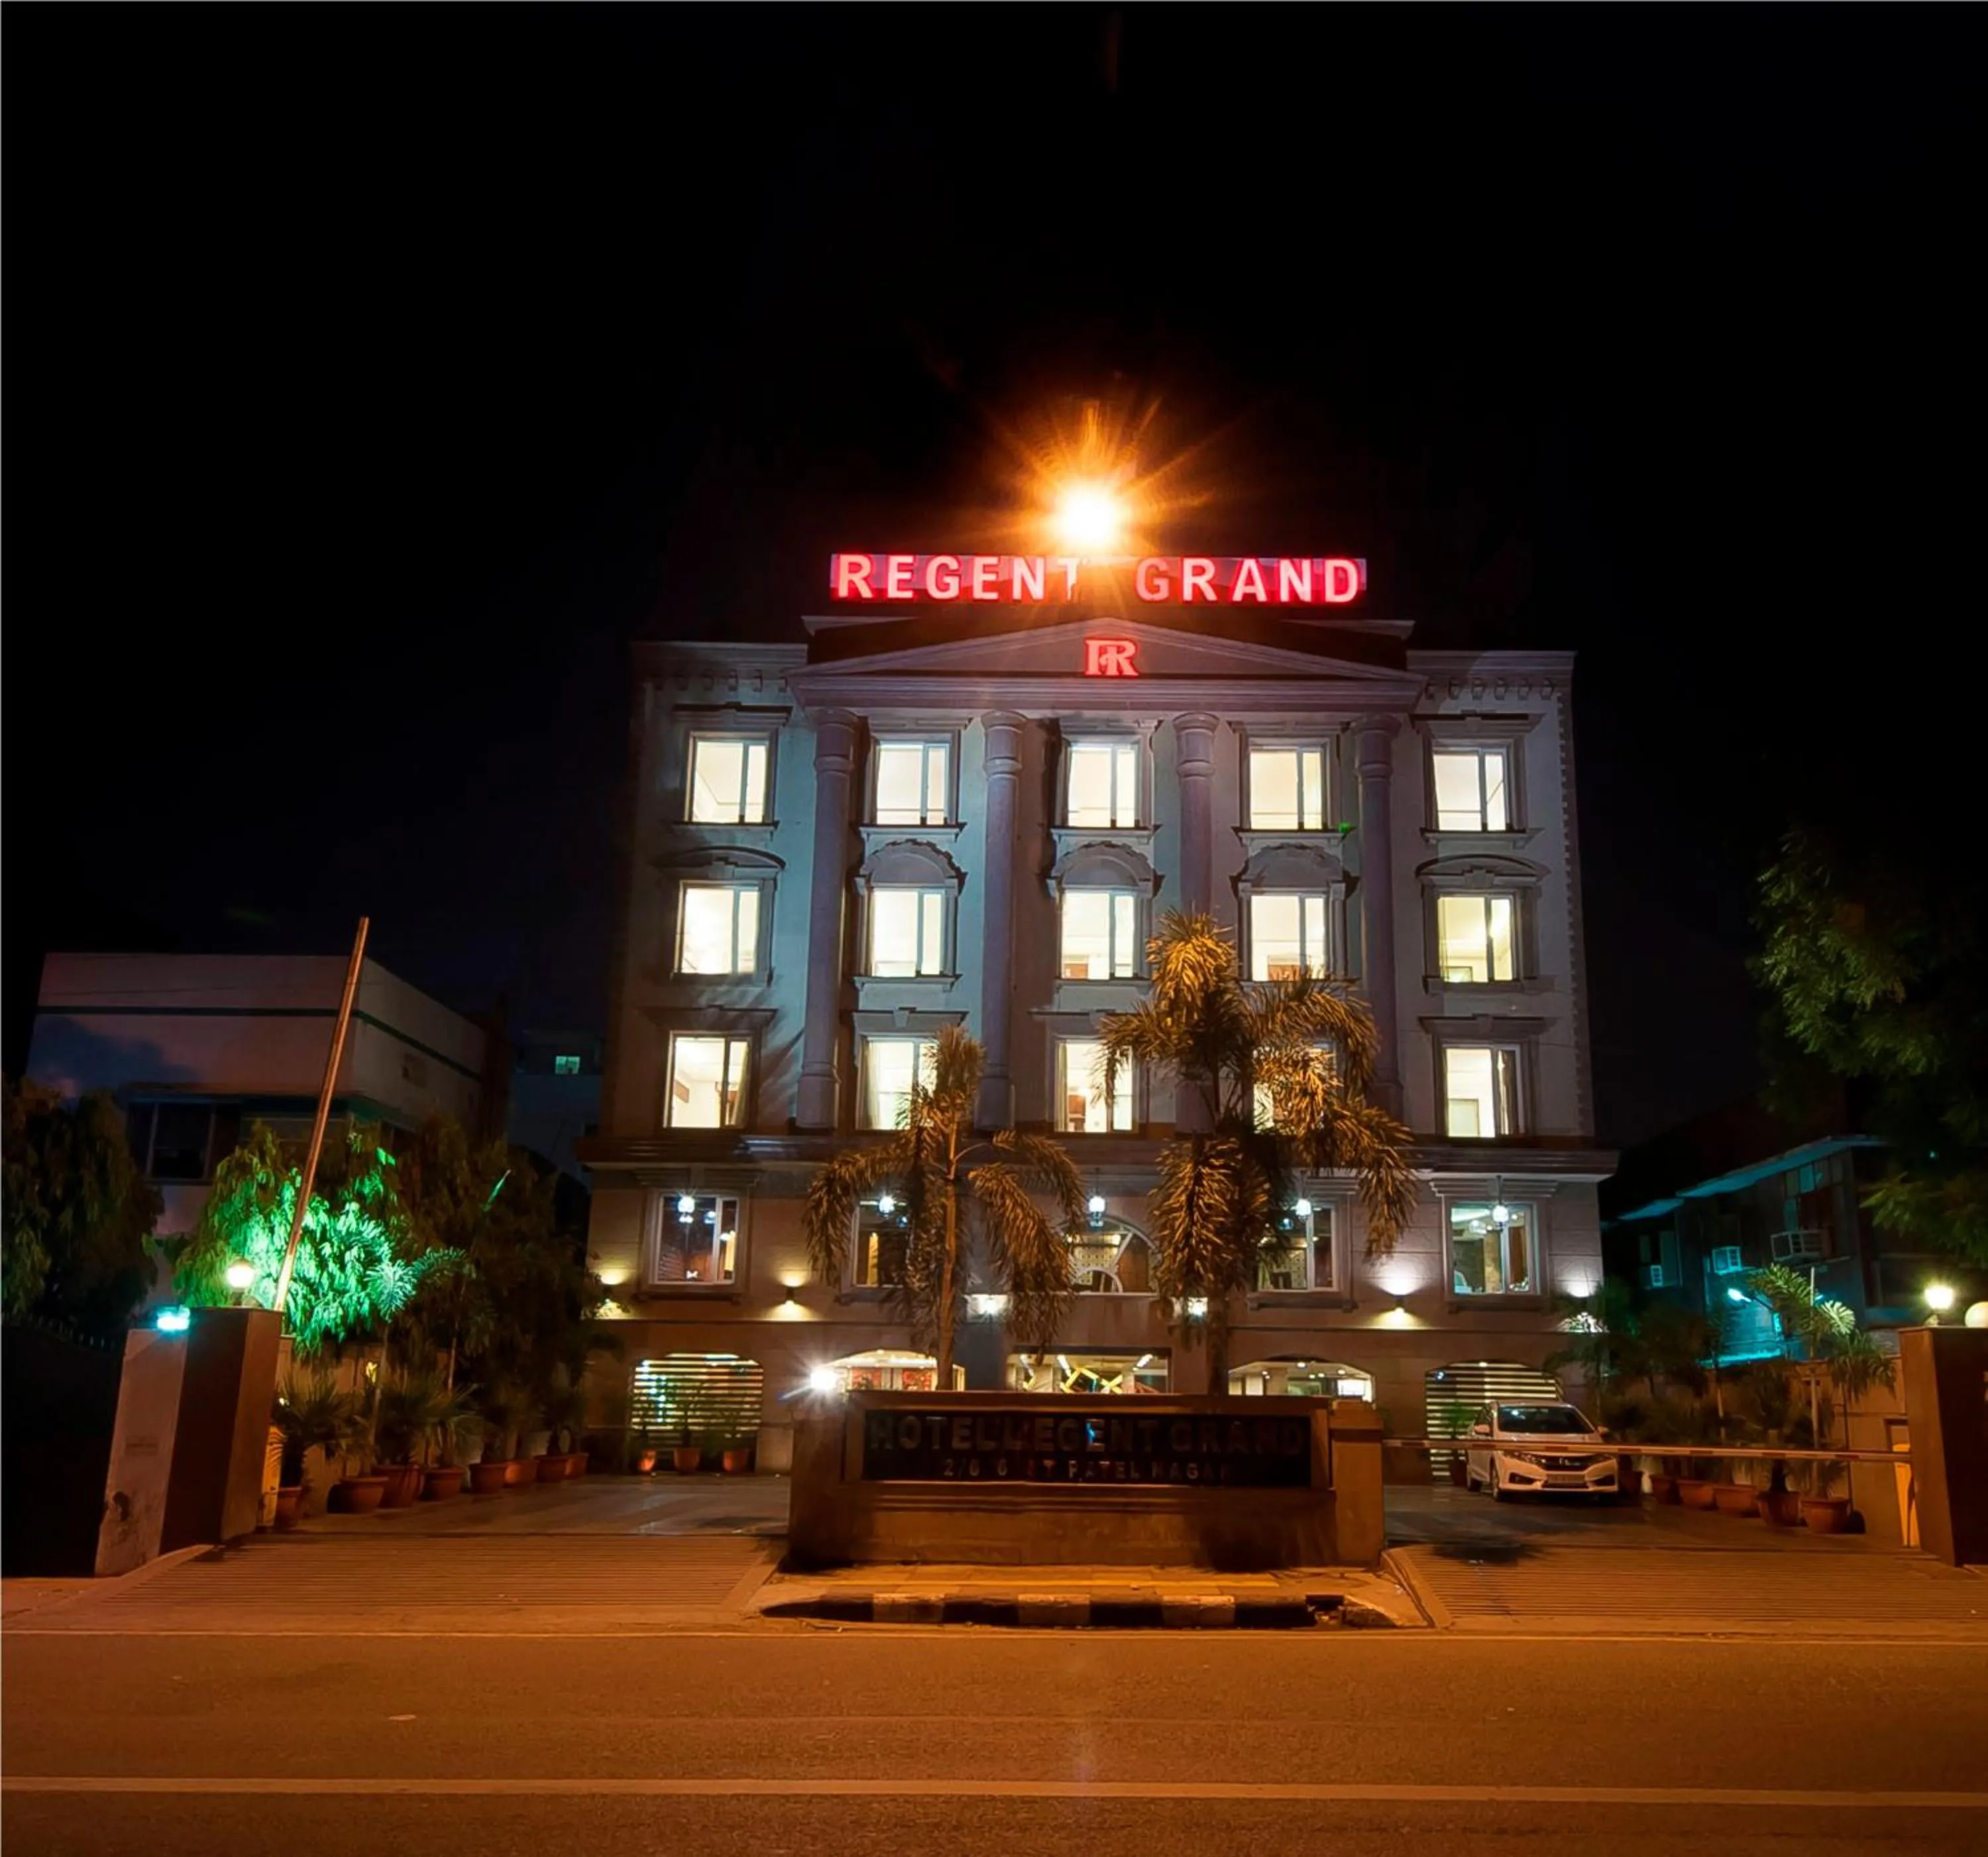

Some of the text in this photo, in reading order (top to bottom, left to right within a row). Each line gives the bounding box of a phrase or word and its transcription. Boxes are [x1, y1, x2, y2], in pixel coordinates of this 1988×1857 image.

[838, 554, 1359, 602] REGENT GRAND
[869, 1415, 995, 1451] HOTEL
